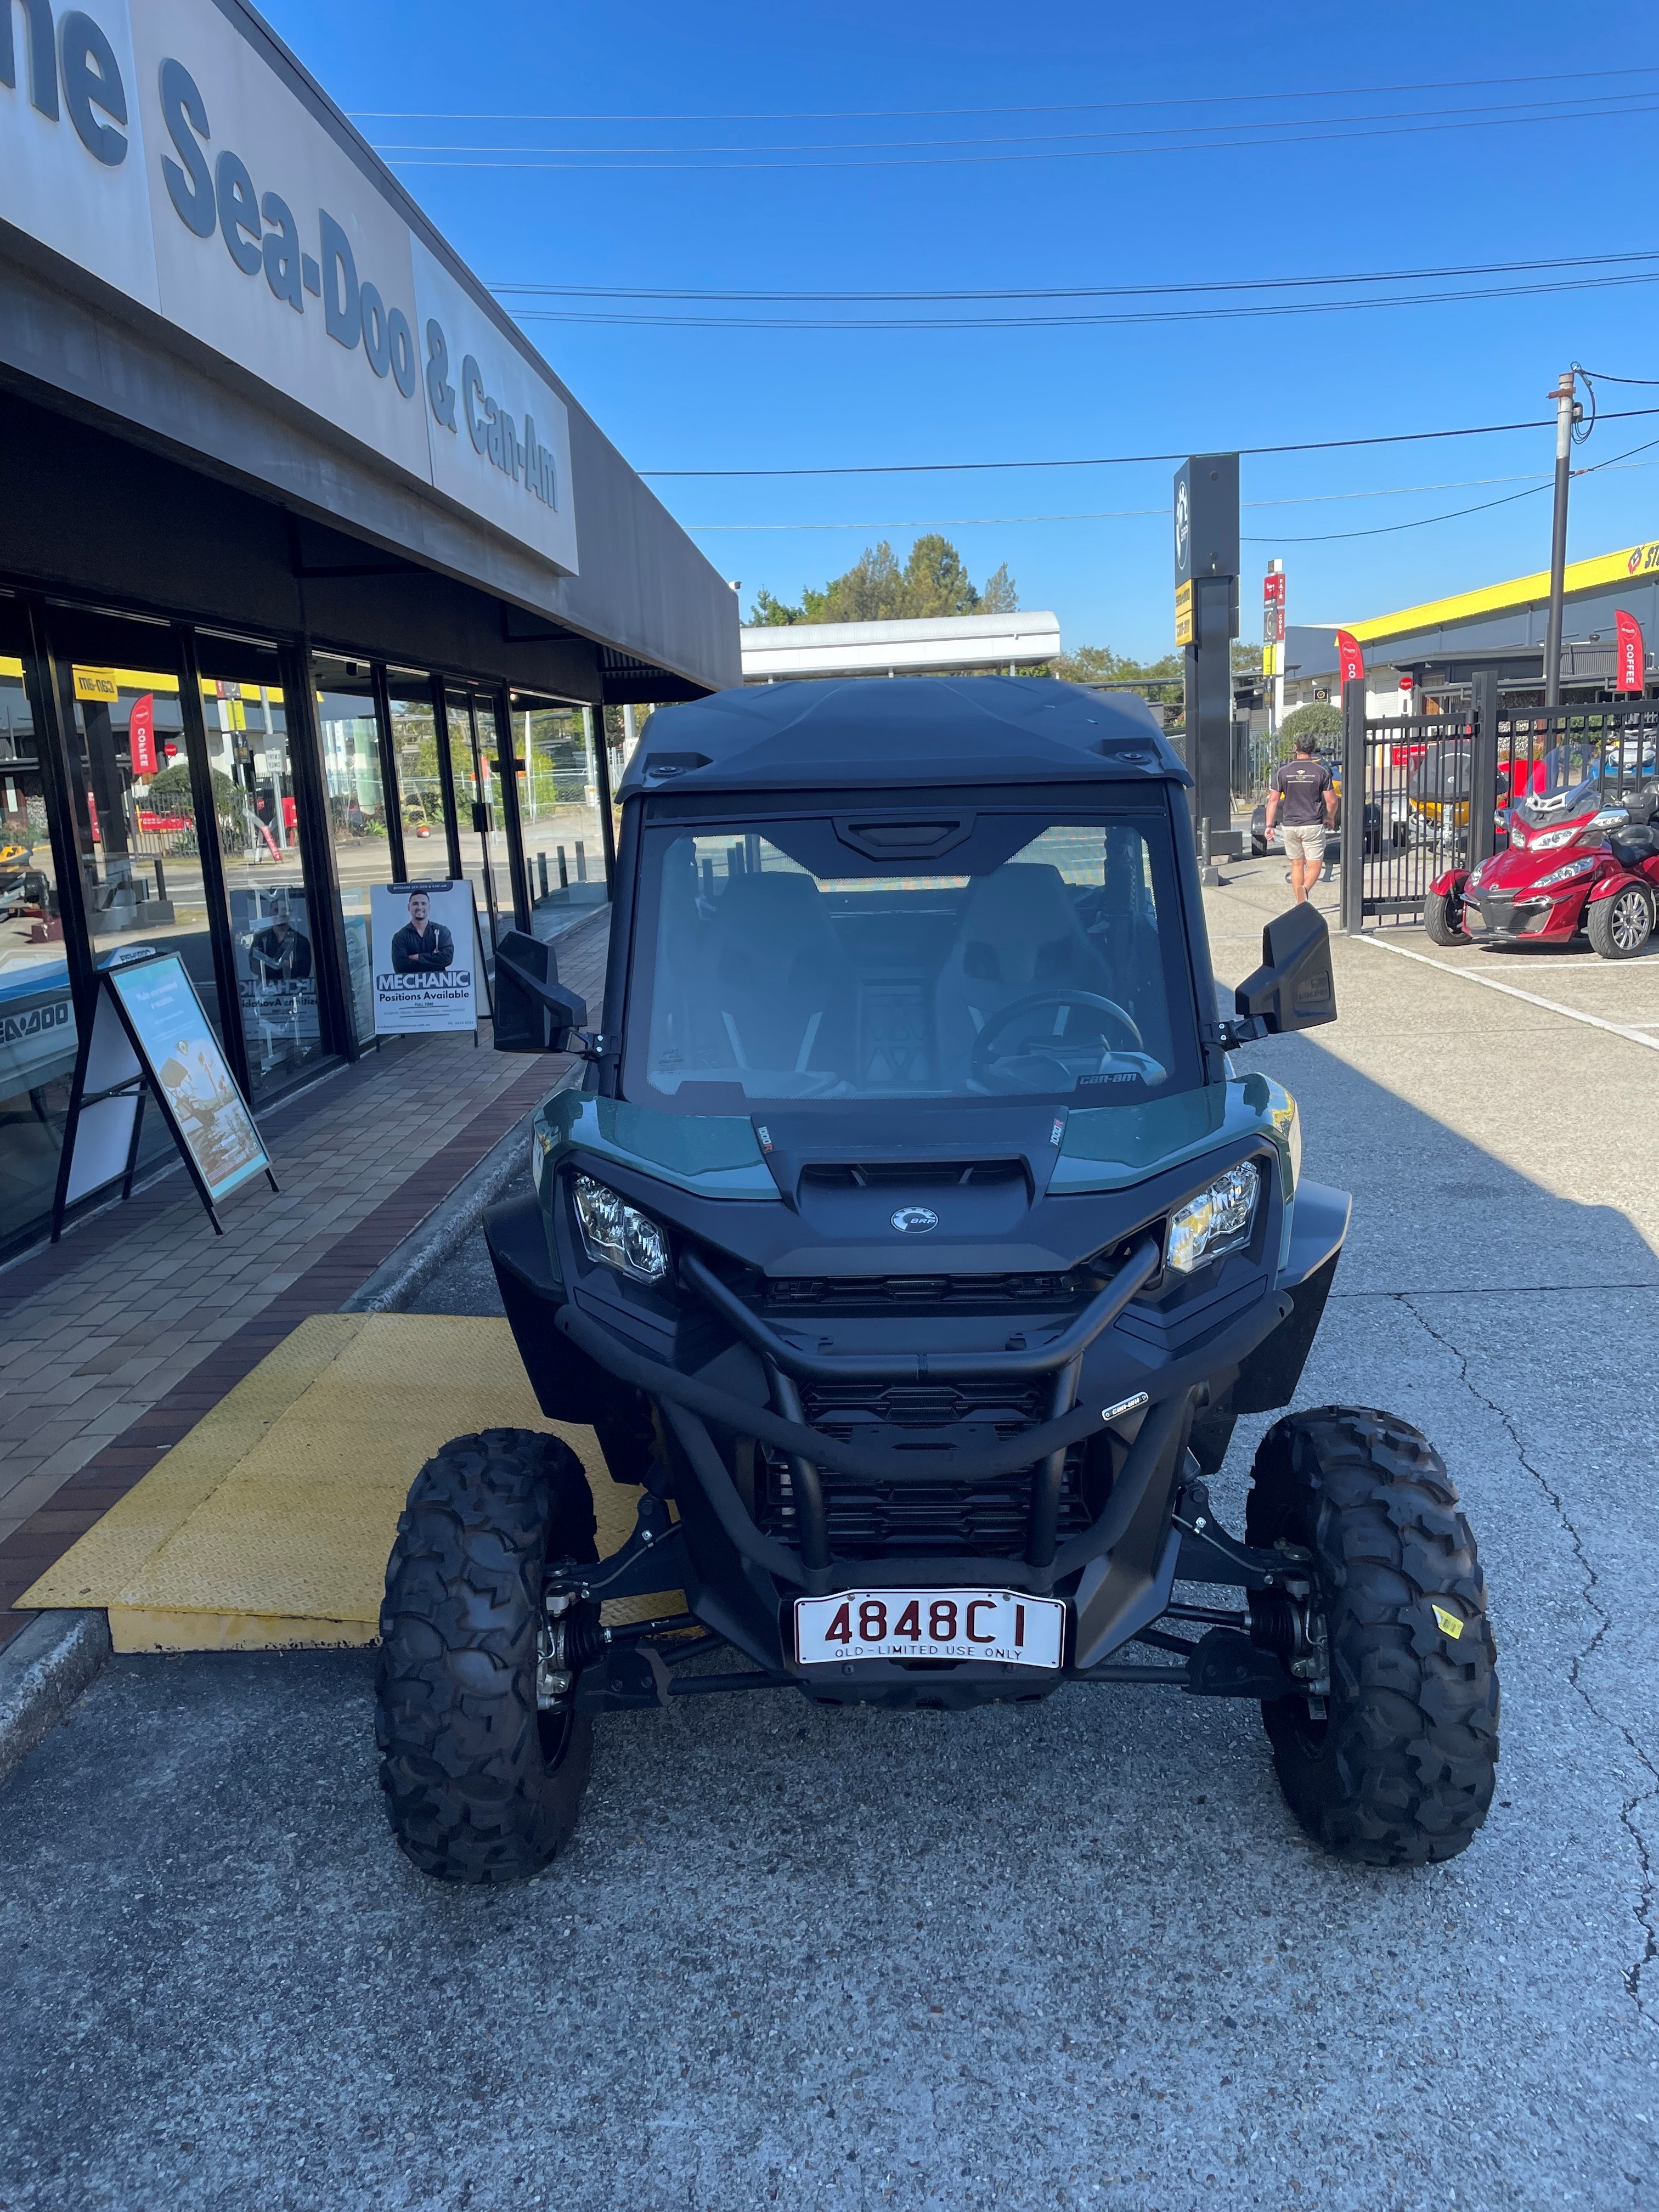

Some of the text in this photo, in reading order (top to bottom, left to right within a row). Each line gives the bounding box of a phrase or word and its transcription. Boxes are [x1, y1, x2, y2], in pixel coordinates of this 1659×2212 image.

[159, 57, 415, 399] Sea-Doo
[426, 318, 458, 433] &
[462, 354, 558, 512] Can-Am
[1644, 545, 1659, 569] ST
[1626, 644, 1635, 684] COFFEE
[379, 972, 469, 990] MECHANIC
[380, 990, 469, 1002] Positions Available
[1080, 1073, 1137, 1085] can-am
[758, 1126, 773, 1154] 1000R
[1049, 1120, 1064, 1146] 1000R
[946, 1645, 975, 1656] USE
[985, 1647, 1023, 1660] ONLY
